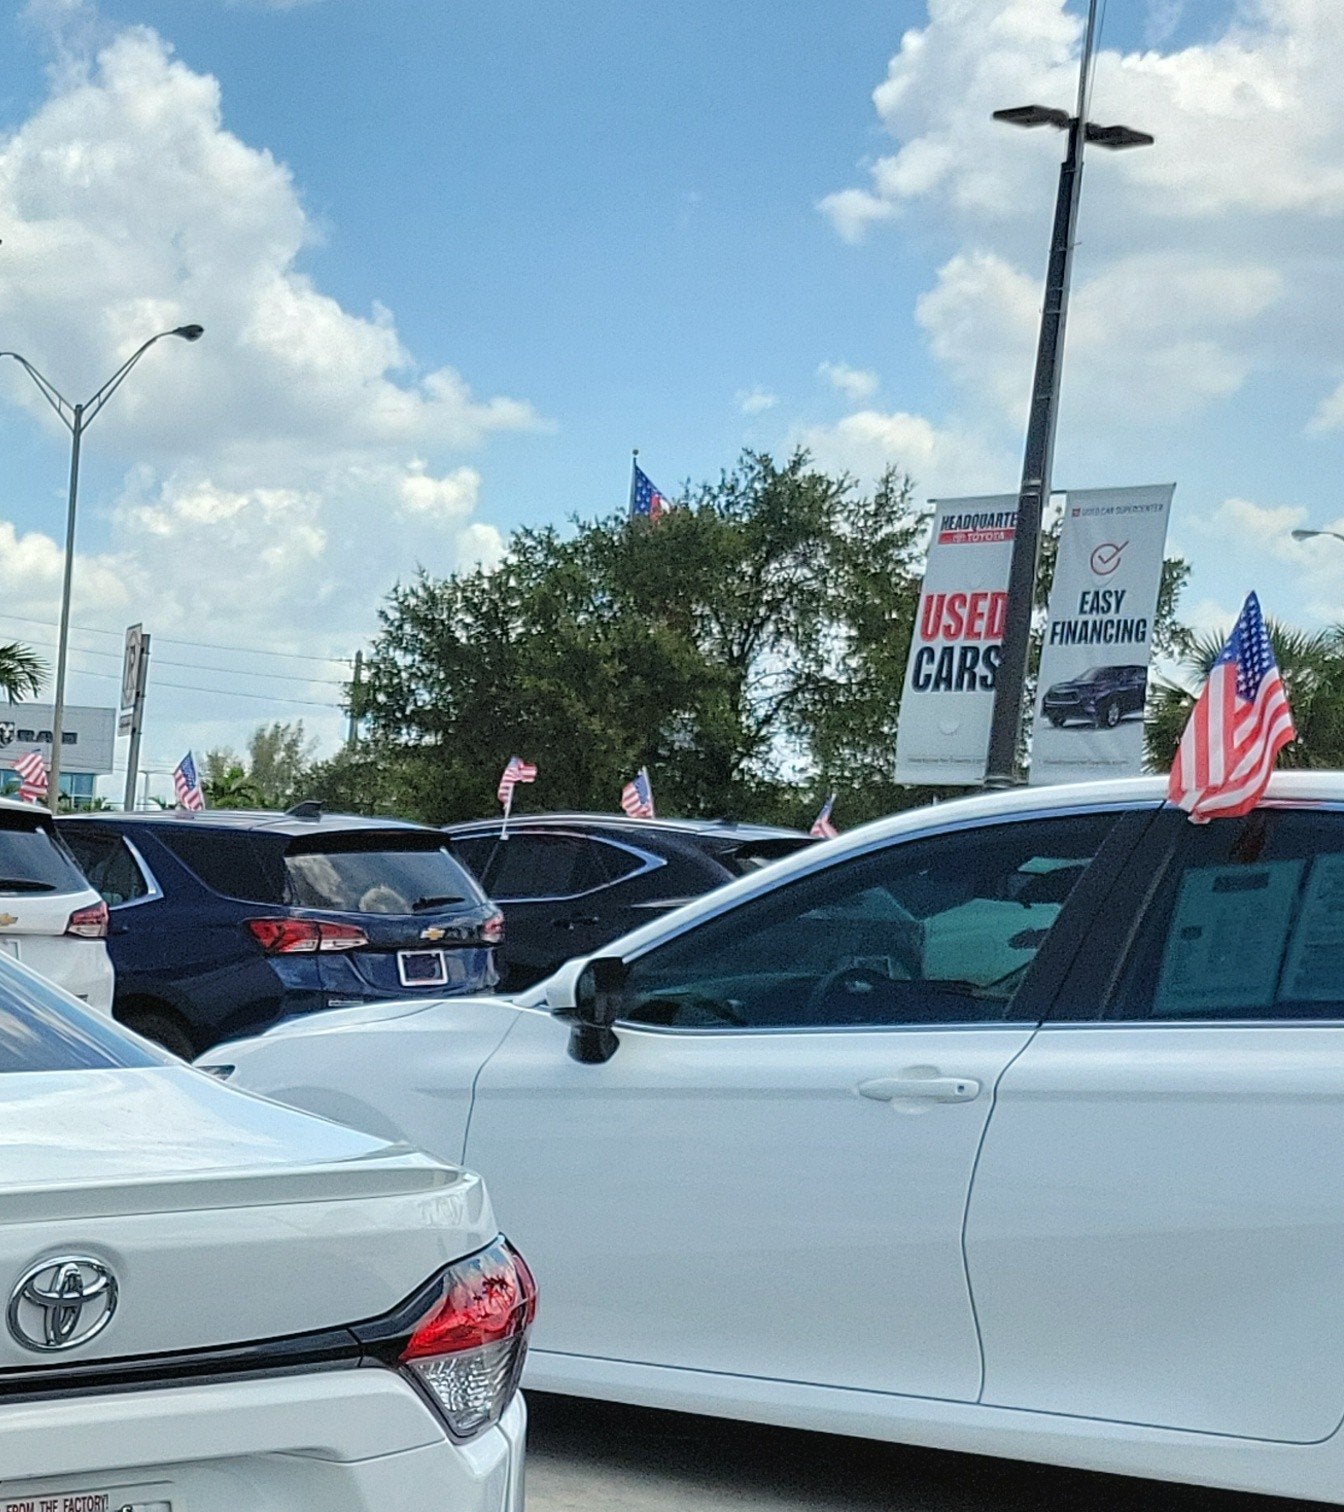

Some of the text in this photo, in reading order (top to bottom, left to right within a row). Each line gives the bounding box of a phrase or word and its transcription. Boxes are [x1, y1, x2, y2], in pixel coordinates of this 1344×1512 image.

[941, 511, 1018, 531] HEADQUARTE
[967, 532, 1005, 542] TOYOTA
[1078, 590, 1126, 615] EASY
[920, 592, 1010, 642] USED
[1049, 619, 1148, 646] FINANCING
[912, 645, 1003, 693] CARS
